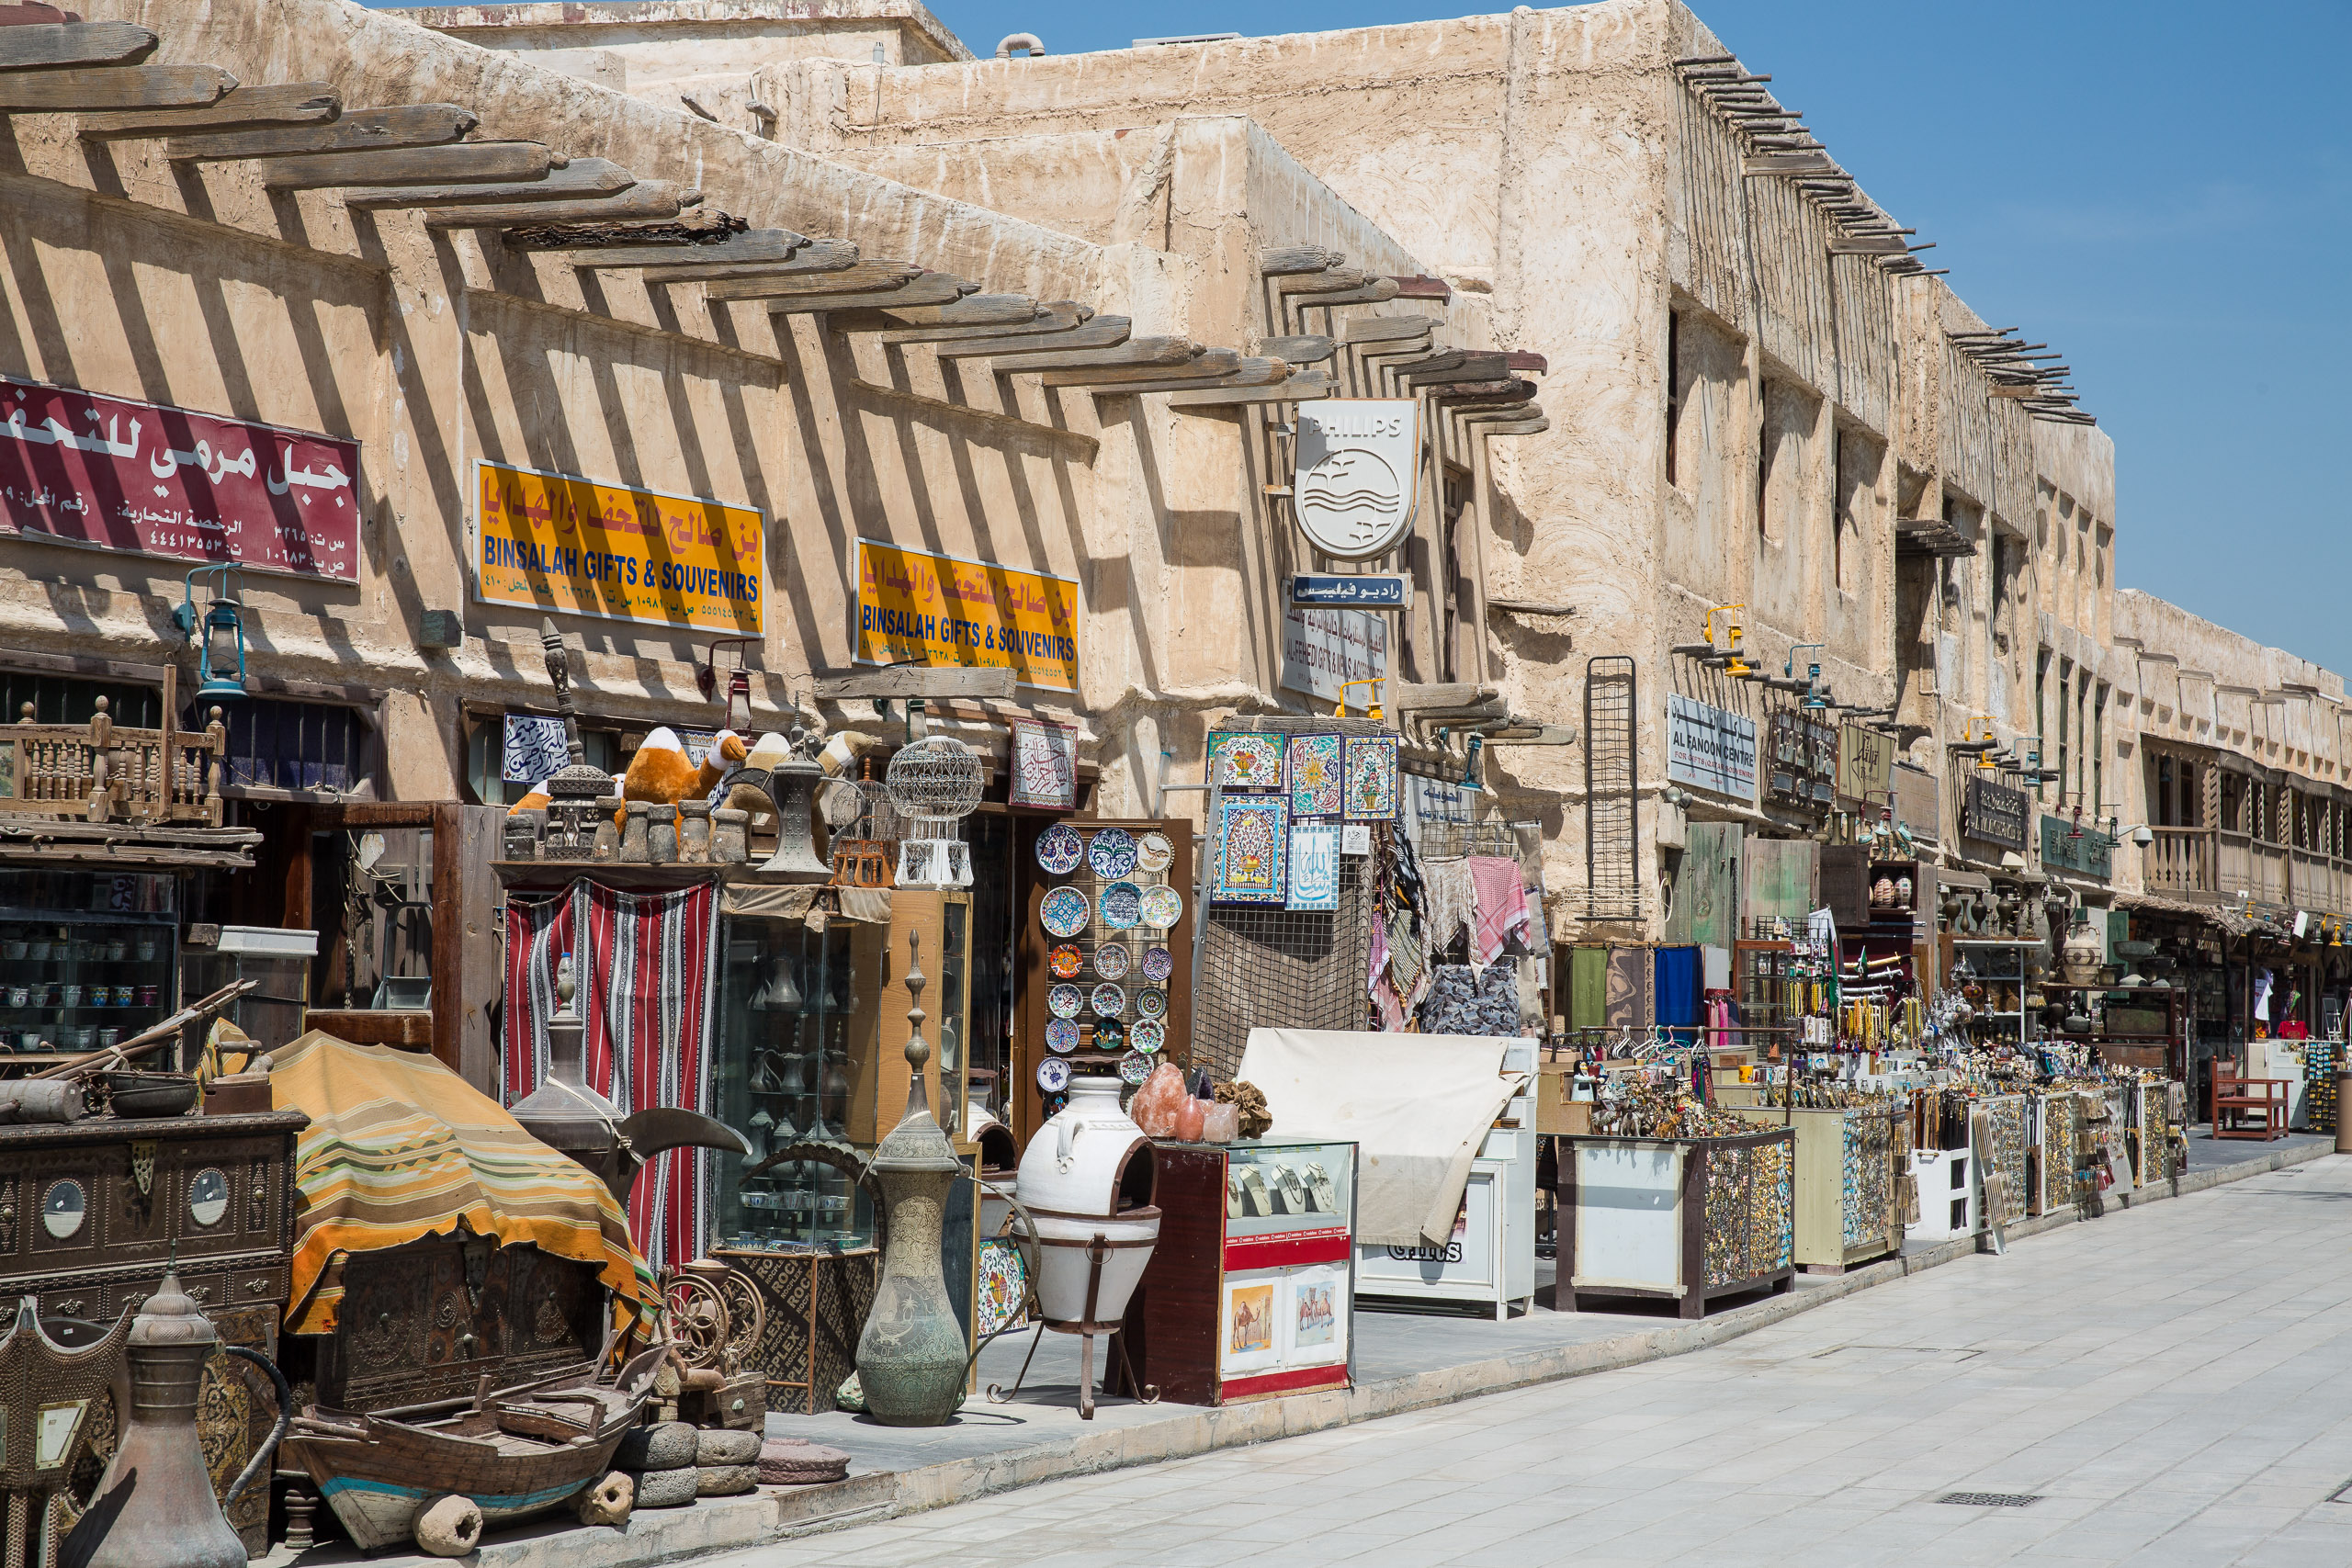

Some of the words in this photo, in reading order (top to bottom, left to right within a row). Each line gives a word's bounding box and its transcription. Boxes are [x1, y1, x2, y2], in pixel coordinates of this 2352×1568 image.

[1308, 416, 1401, 437] PHILIPS
[150, 438, 256, 498] مرمي
[267, 443, 351, 507] جبل
[60, 491, 89, 515] رقم
[186, 509, 242, 536] الرخصة
[483, 476, 578, 535] والهدايا
[586, 493, 662, 537] للتحف
[668, 511, 723, 554] صالح
[731, 522, 758, 563] بن
[484, 535, 578, 577] BINSALAH
[583, 551, 638, 585] GIFTS
[643, 558, 656, 588] &
[662, 561, 758, 603] SOUVENIRS
[863, 552, 934, 603] والهدايا
[940, 567, 997, 604] للتحف
[1003, 581, 1046, 620] صالح
[1051, 590, 1073, 628] بن
[1360, 583, 1399, 600] راديو
[863, 604, 935, 641] BINSALAH
[940, 616, 980, 648] GIFTS
[985, 625, 995, 649] &
[999, 626, 1074, 662] SOUVENIRS
[1673, 731, 1685, 747] AL
[1687, 734, 1722, 758] FANOON
[1723, 745, 1754, 767] CENTRE
[1674, 750, 1687, 761] FOR
[1688, 755, 1704, 765] GIFTS
[880, 1348, 894, 1357] OF
